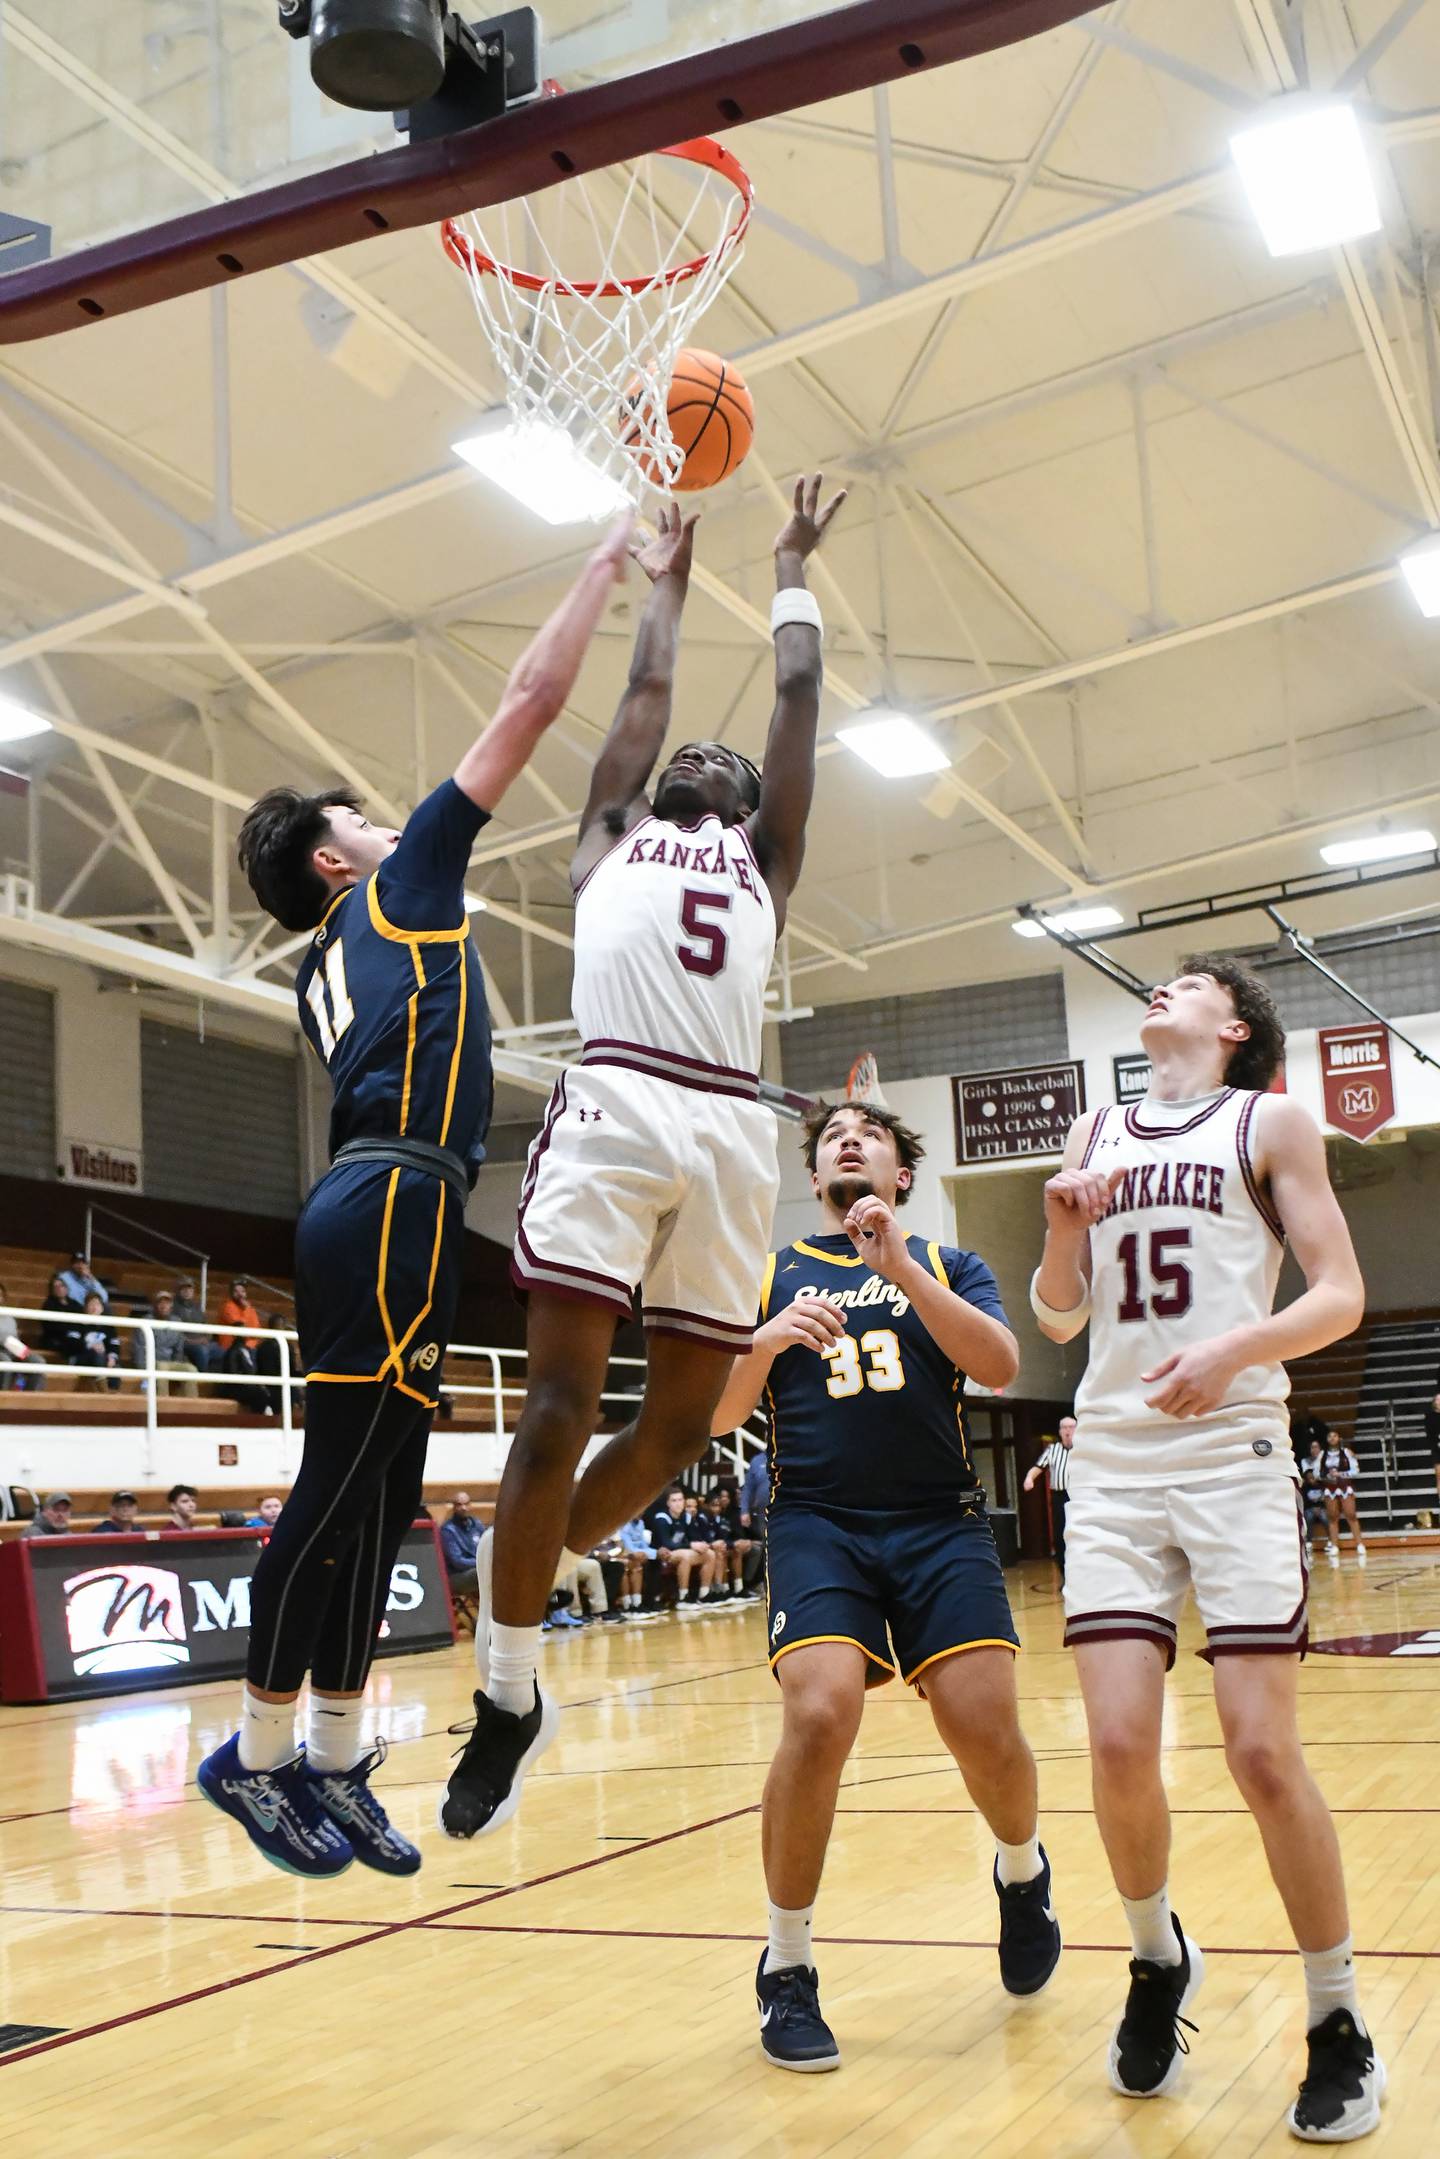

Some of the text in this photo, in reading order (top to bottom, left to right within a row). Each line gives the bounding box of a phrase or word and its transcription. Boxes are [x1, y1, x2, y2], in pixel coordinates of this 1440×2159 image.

[627, 838, 764, 910] KANKAE
[676, 885, 734, 981] 5
[306, 936, 355, 1064] 11
[1330, 1040, 1381, 1067] Morris
[964, 1073, 1074, 1100] Girls Basketball
[1343, 1087, 1374, 1115] M
[966, 1112, 1076, 1138] IHSA CLASS AA
[1004, 1099, 1037, 1116] 1996
[71, 1144, 138, 1186] Visitors
[977, 1140, 1007, 1157] 4TH
[1117, 1225, 1193, 1324] 15
[820, 1328, 906, 1400] 33
